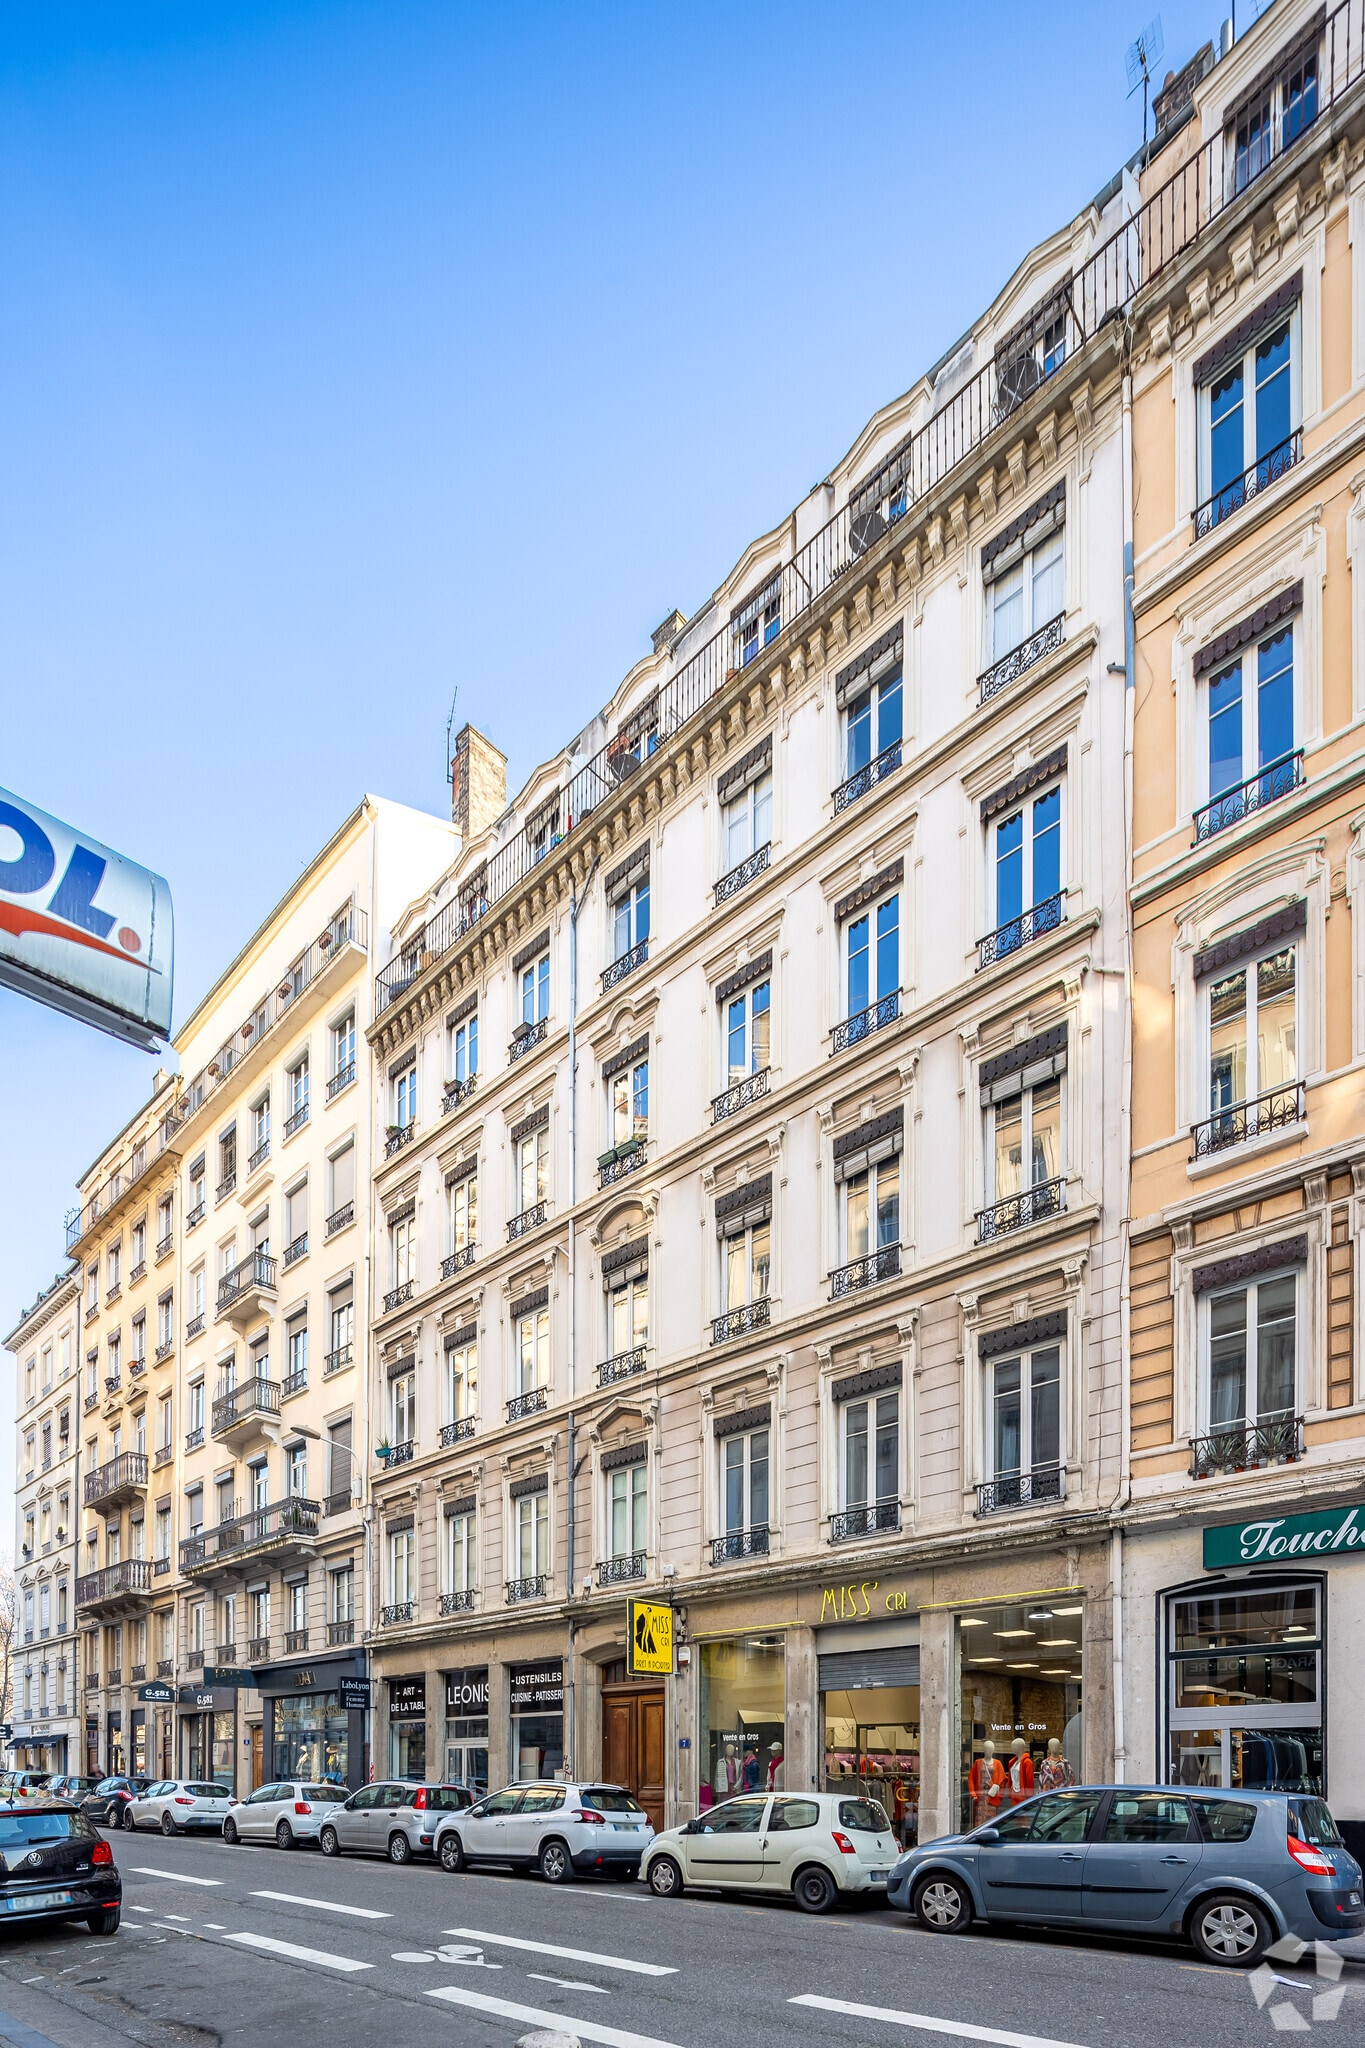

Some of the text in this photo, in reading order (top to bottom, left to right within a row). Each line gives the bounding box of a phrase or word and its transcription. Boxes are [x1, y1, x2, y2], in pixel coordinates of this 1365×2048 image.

[885, 1591, 907, 1611] CRI
[341, 1680, 370, 1692] LaboLyon
[402, 1686, 416, 1696] ART
[511, 1691, 532, 1703] CUISINE
[390, 1703, 400, 1712] DE
[400, 1702, 409, 1712] LA
[990, 1723, 1012, 1731] Vente
[1027, 1722, 1047, 1731] Gros
[722, 1734, 738, 1742] Vente
[746, 1733, 760, 1741] Gros
